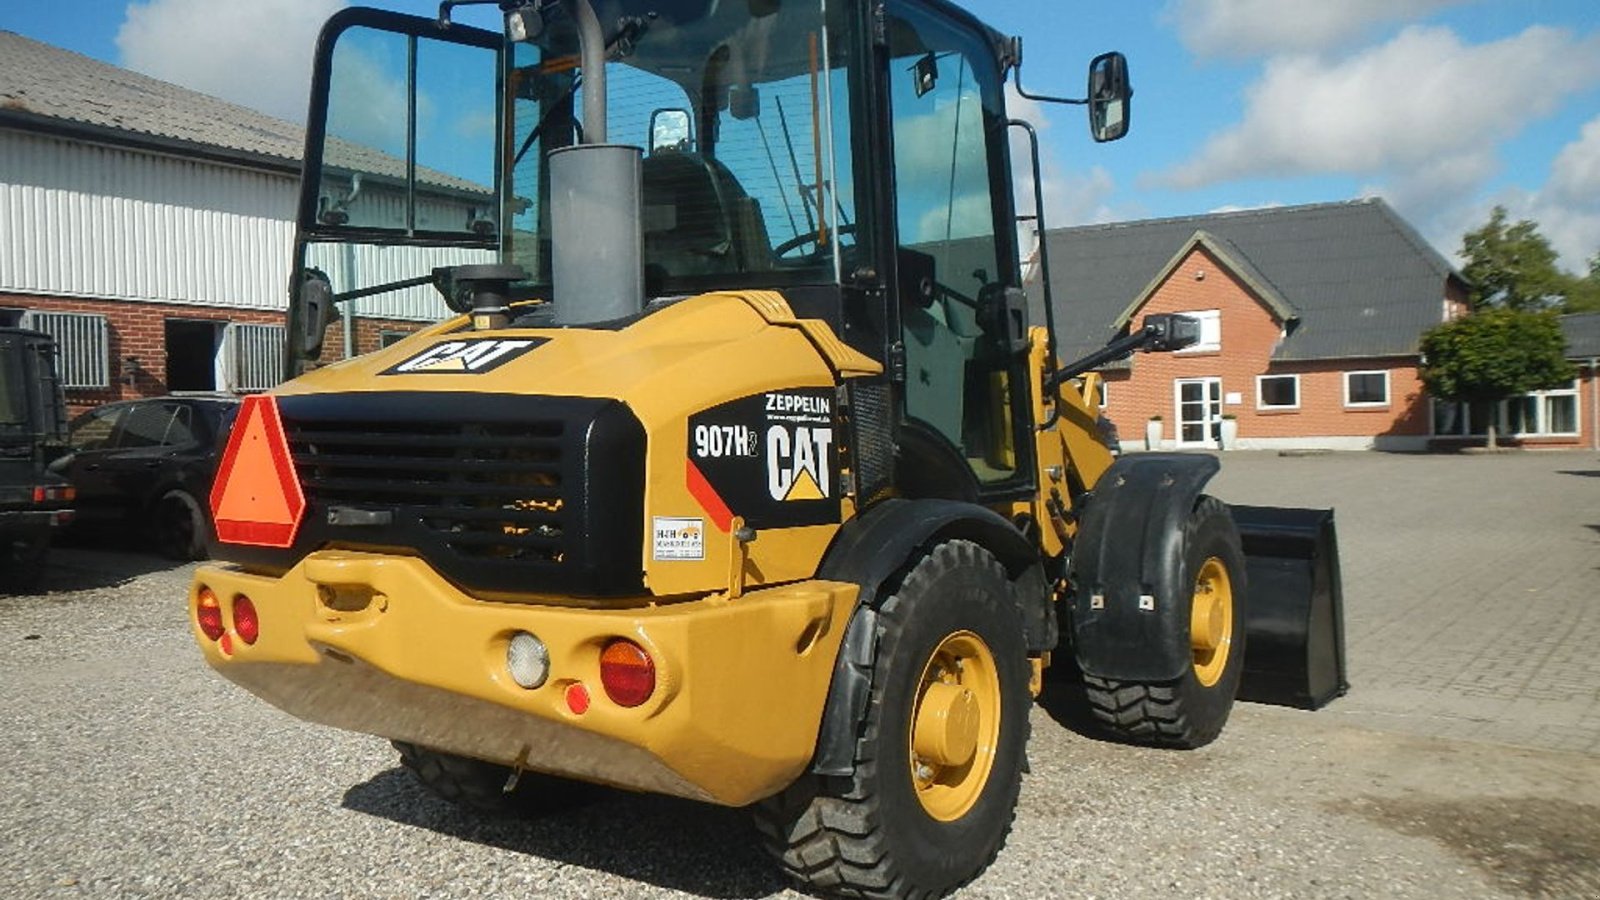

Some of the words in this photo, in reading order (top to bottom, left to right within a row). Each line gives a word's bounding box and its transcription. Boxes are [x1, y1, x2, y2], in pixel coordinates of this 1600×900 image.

[397, 341, 534, 371] CAT
[765, 394, 830, 413] ZEPPELIN
[766, 425, 832, 501] CAT
